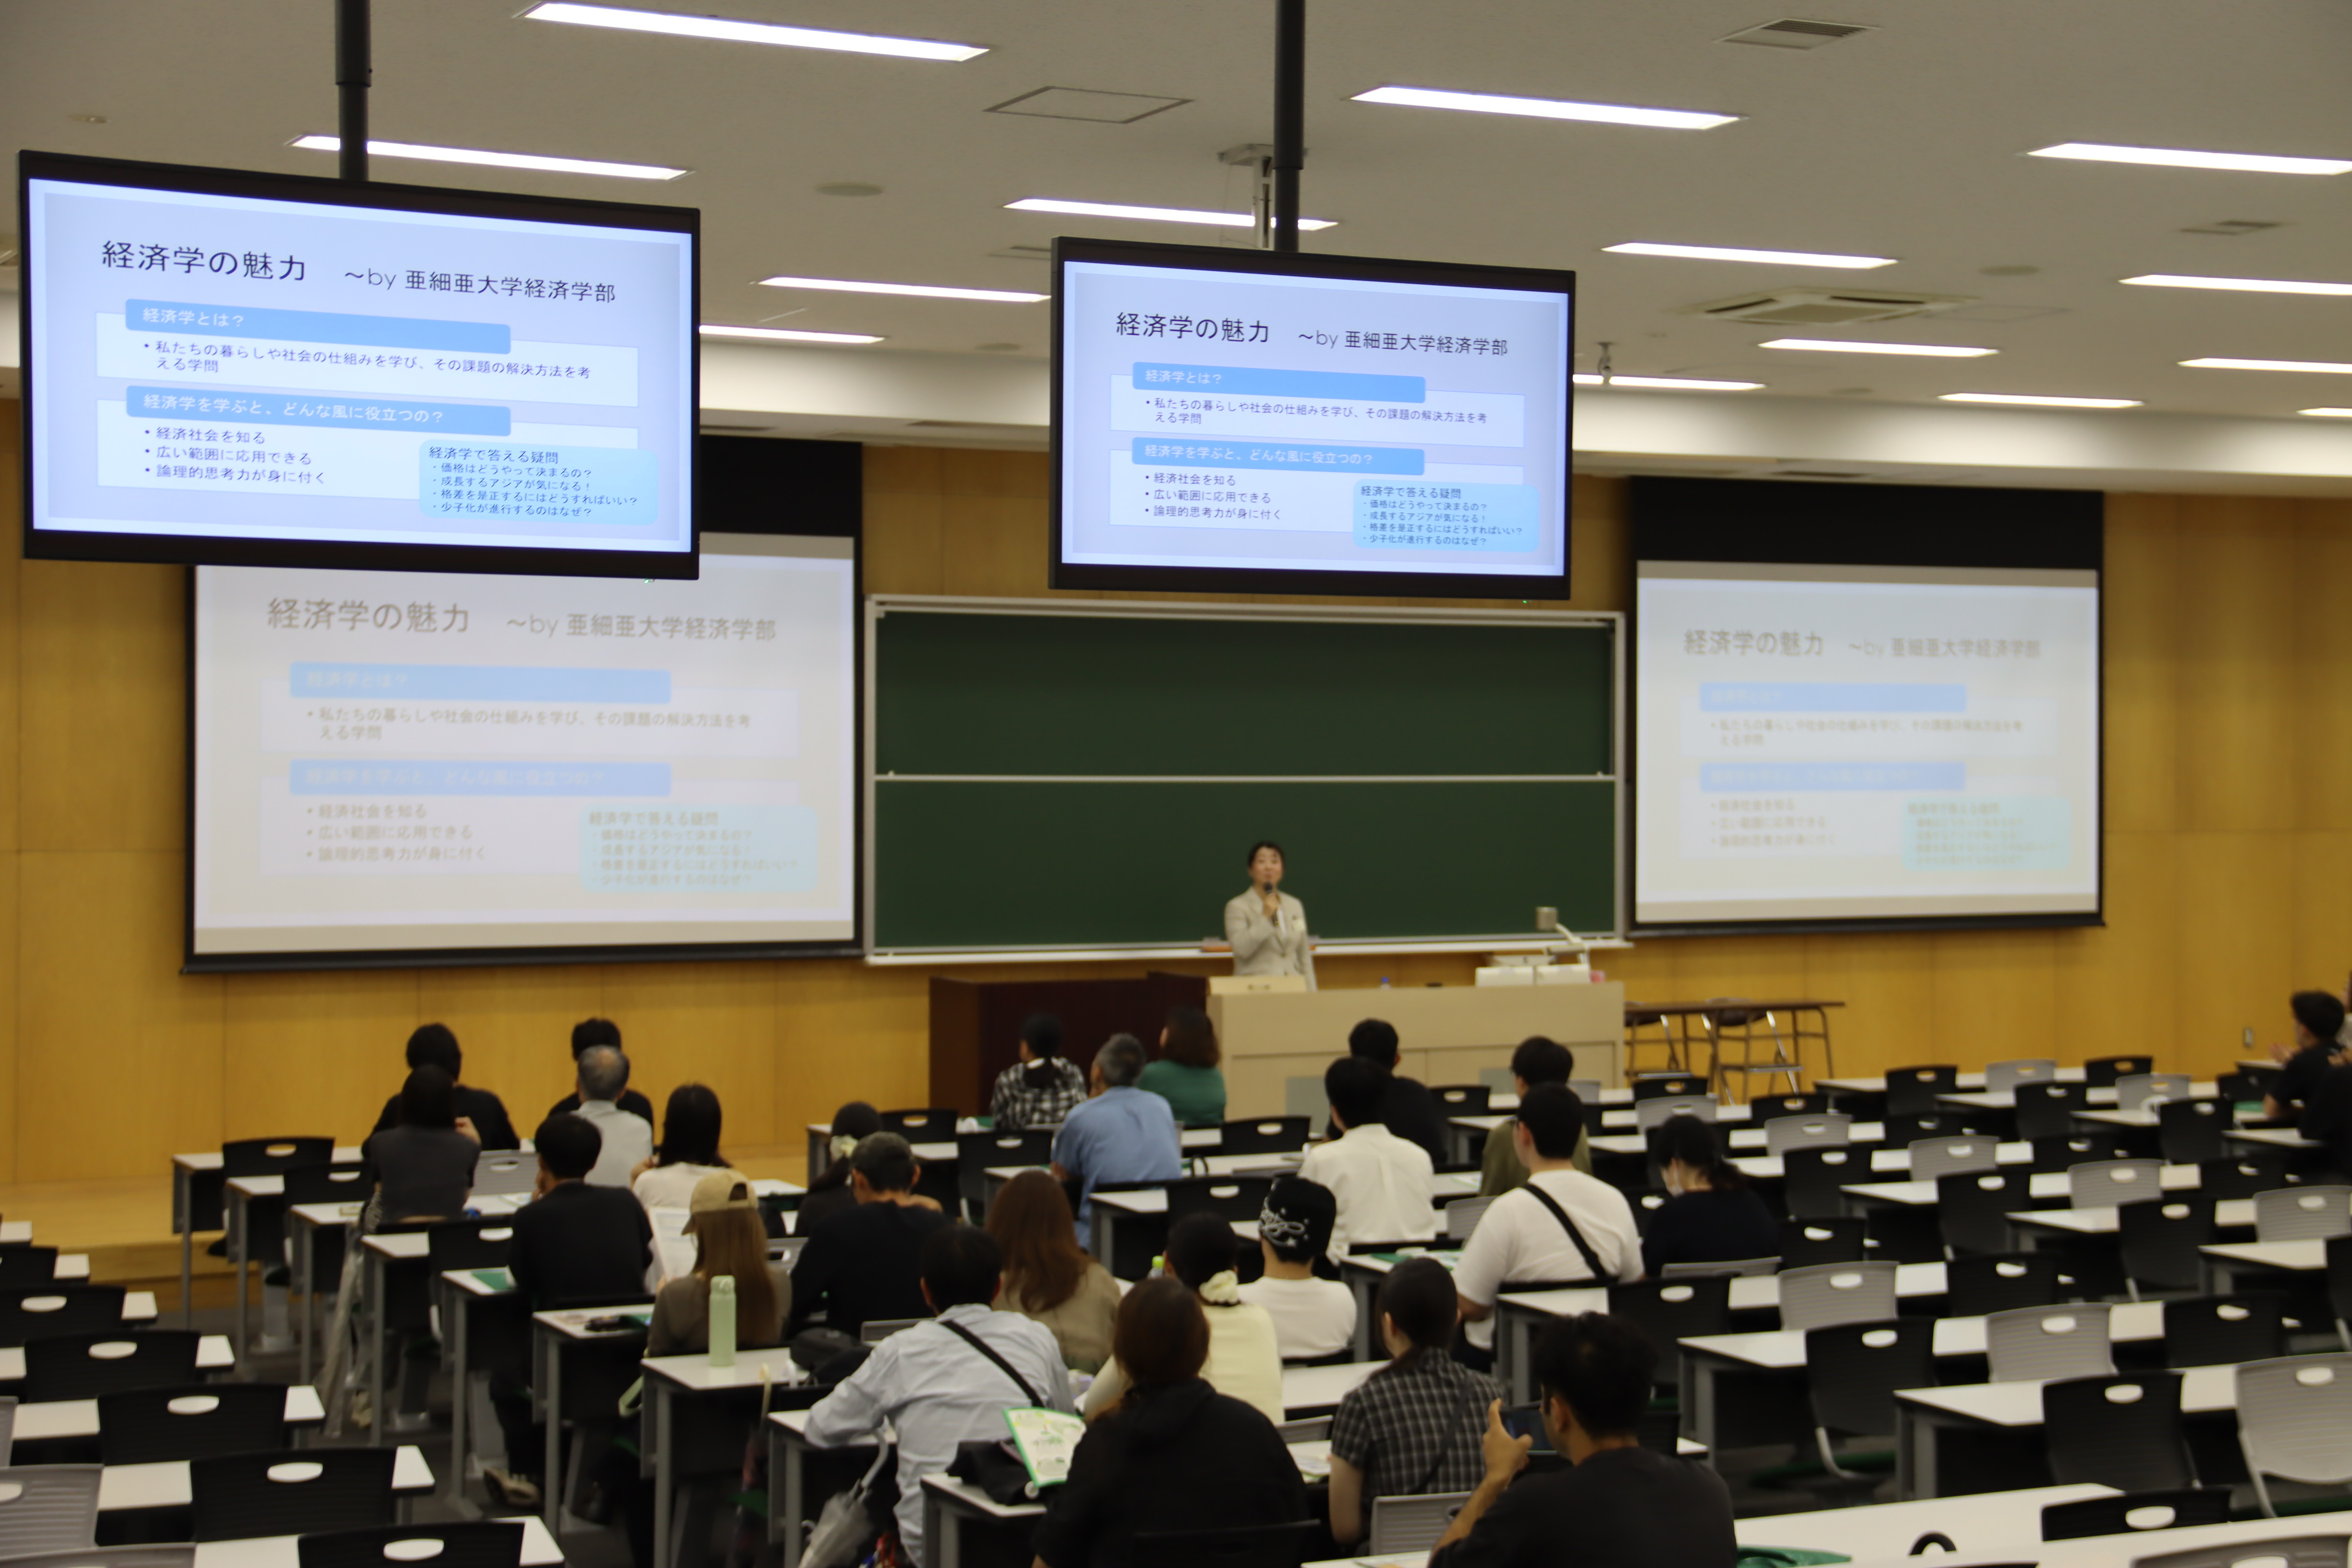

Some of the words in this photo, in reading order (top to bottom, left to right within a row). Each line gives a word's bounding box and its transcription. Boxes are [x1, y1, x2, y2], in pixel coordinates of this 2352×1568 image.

[102, 241, 305, 280] 経済学の魅力
[405, 270, 615, 303] 亜細亜大学経済学部
[1116, 312, 1269, 343] 経済学の魅力
[1345, 331, 1508, 356] 亜細亜大学経済学部
[157, 359, 219, 373] える学問
[1155, 413, 1201, 424] える学問
[156, 427, 265, 444] 経済社会を知る
[157, 446, 312, 466] 広い範囲に応用できる
[429, 446, 559, 464] 経済学で答える疑問
[157, 465, 325, 484] 論理的思考力が身に付く
[1154, 472, 1236, 486] 経済社会を知る
[1154, 490, 1271, 503] 広い範囲に応用できる
[1361, 486, 1461, 499] 経済学で答える疑問
[1153, 505, 1280, 519] 論理的思考力が身に付く
[268, 597, 469, 632] 経済学の魅力
[566, 613, 777, 641] 亜細亜大学経済学部
